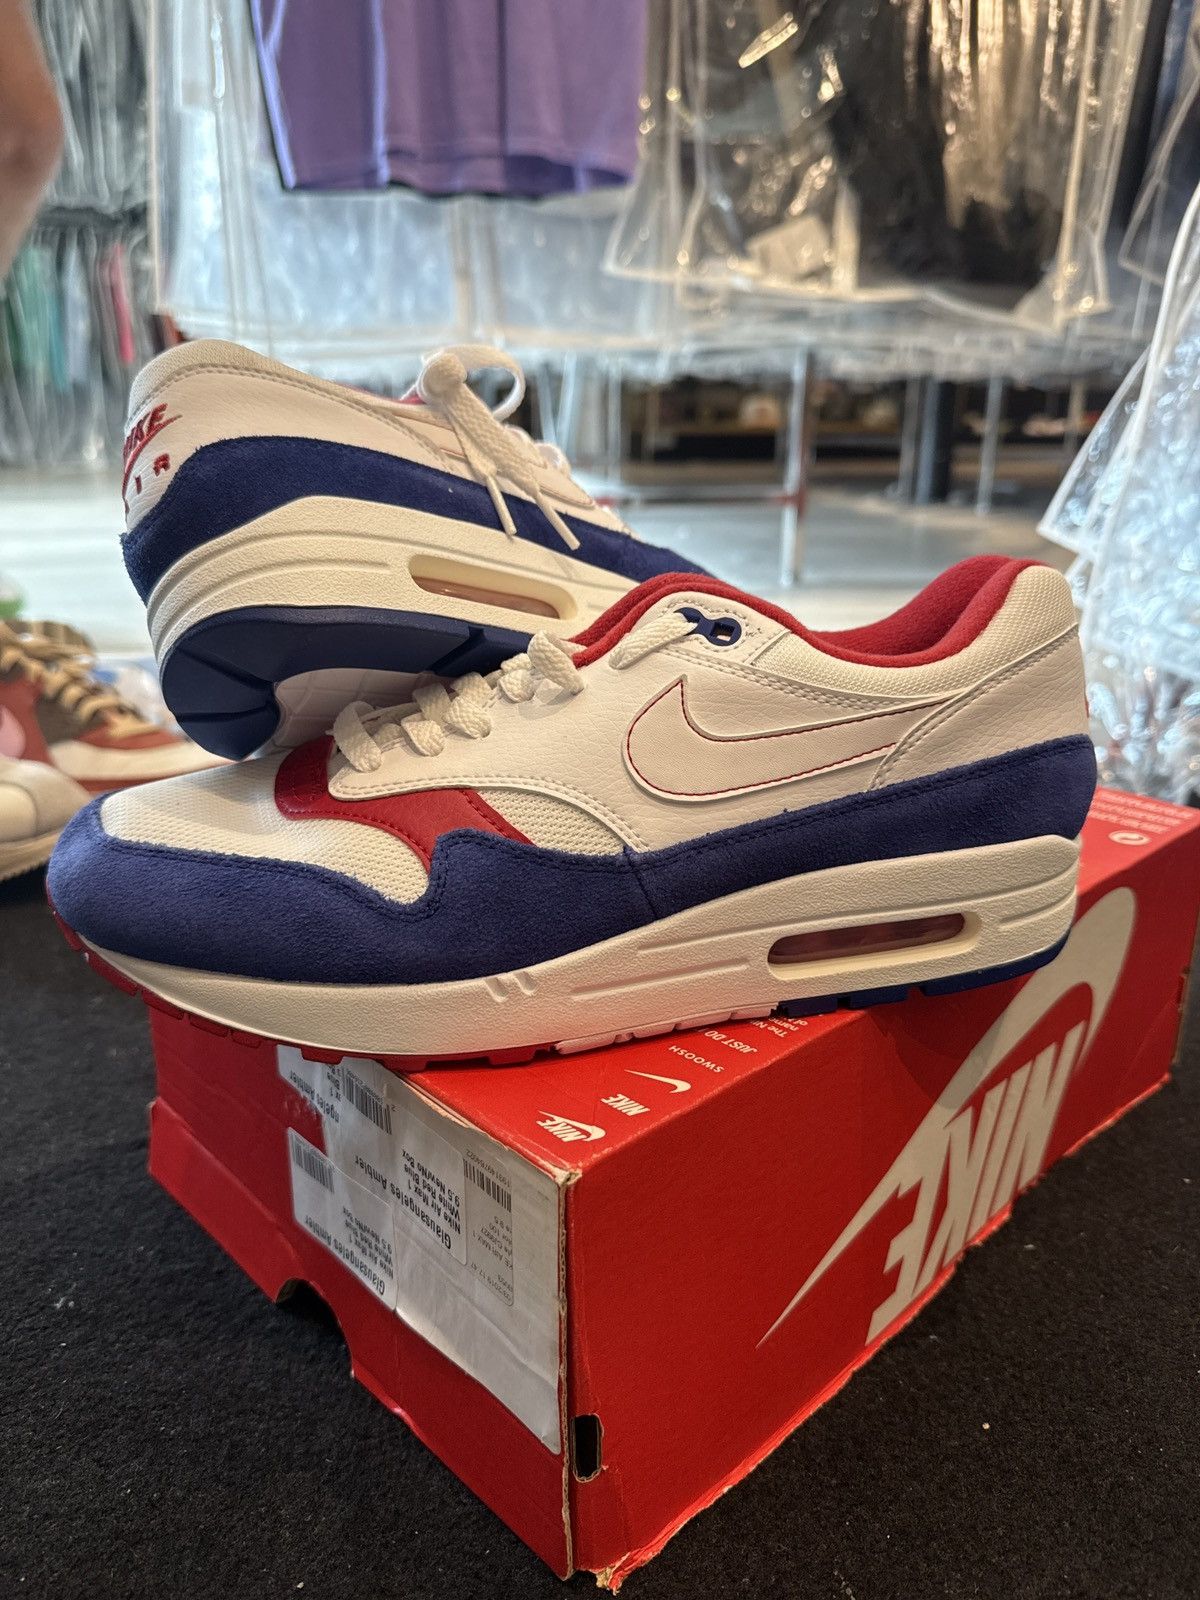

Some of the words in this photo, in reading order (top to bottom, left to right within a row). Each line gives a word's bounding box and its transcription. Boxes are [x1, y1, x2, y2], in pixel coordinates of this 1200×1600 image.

[704, 1030, 727, 1041] DO
[767, 1026, 788, 1038] The
[722, 1038, 758, 1054] JUST
[668, 1045, 725, 1073] SWOOSH
[601, 1093, 651, 1116] NIKE
[536, 1117, 588, 1142] NIKE
[402, 1149, 414, 1167] Box
[355, 1154, 386, 1191] Ambler
[404, 1163, 419, 1184] Blue
[866, 1020, 1088, 1346] NIKE
[414, 1184, 428, 1206] Max
[422, 1178, 435, 1199] Red
[448, 1188, 459, 1207] 9.5
[390, 1182, 450, 1250] Glausangeles
[431, 1199, 441, 1217] Air
[438, 1193, 459, 1221] White
[443, 1210, 460, 1234] Nike
